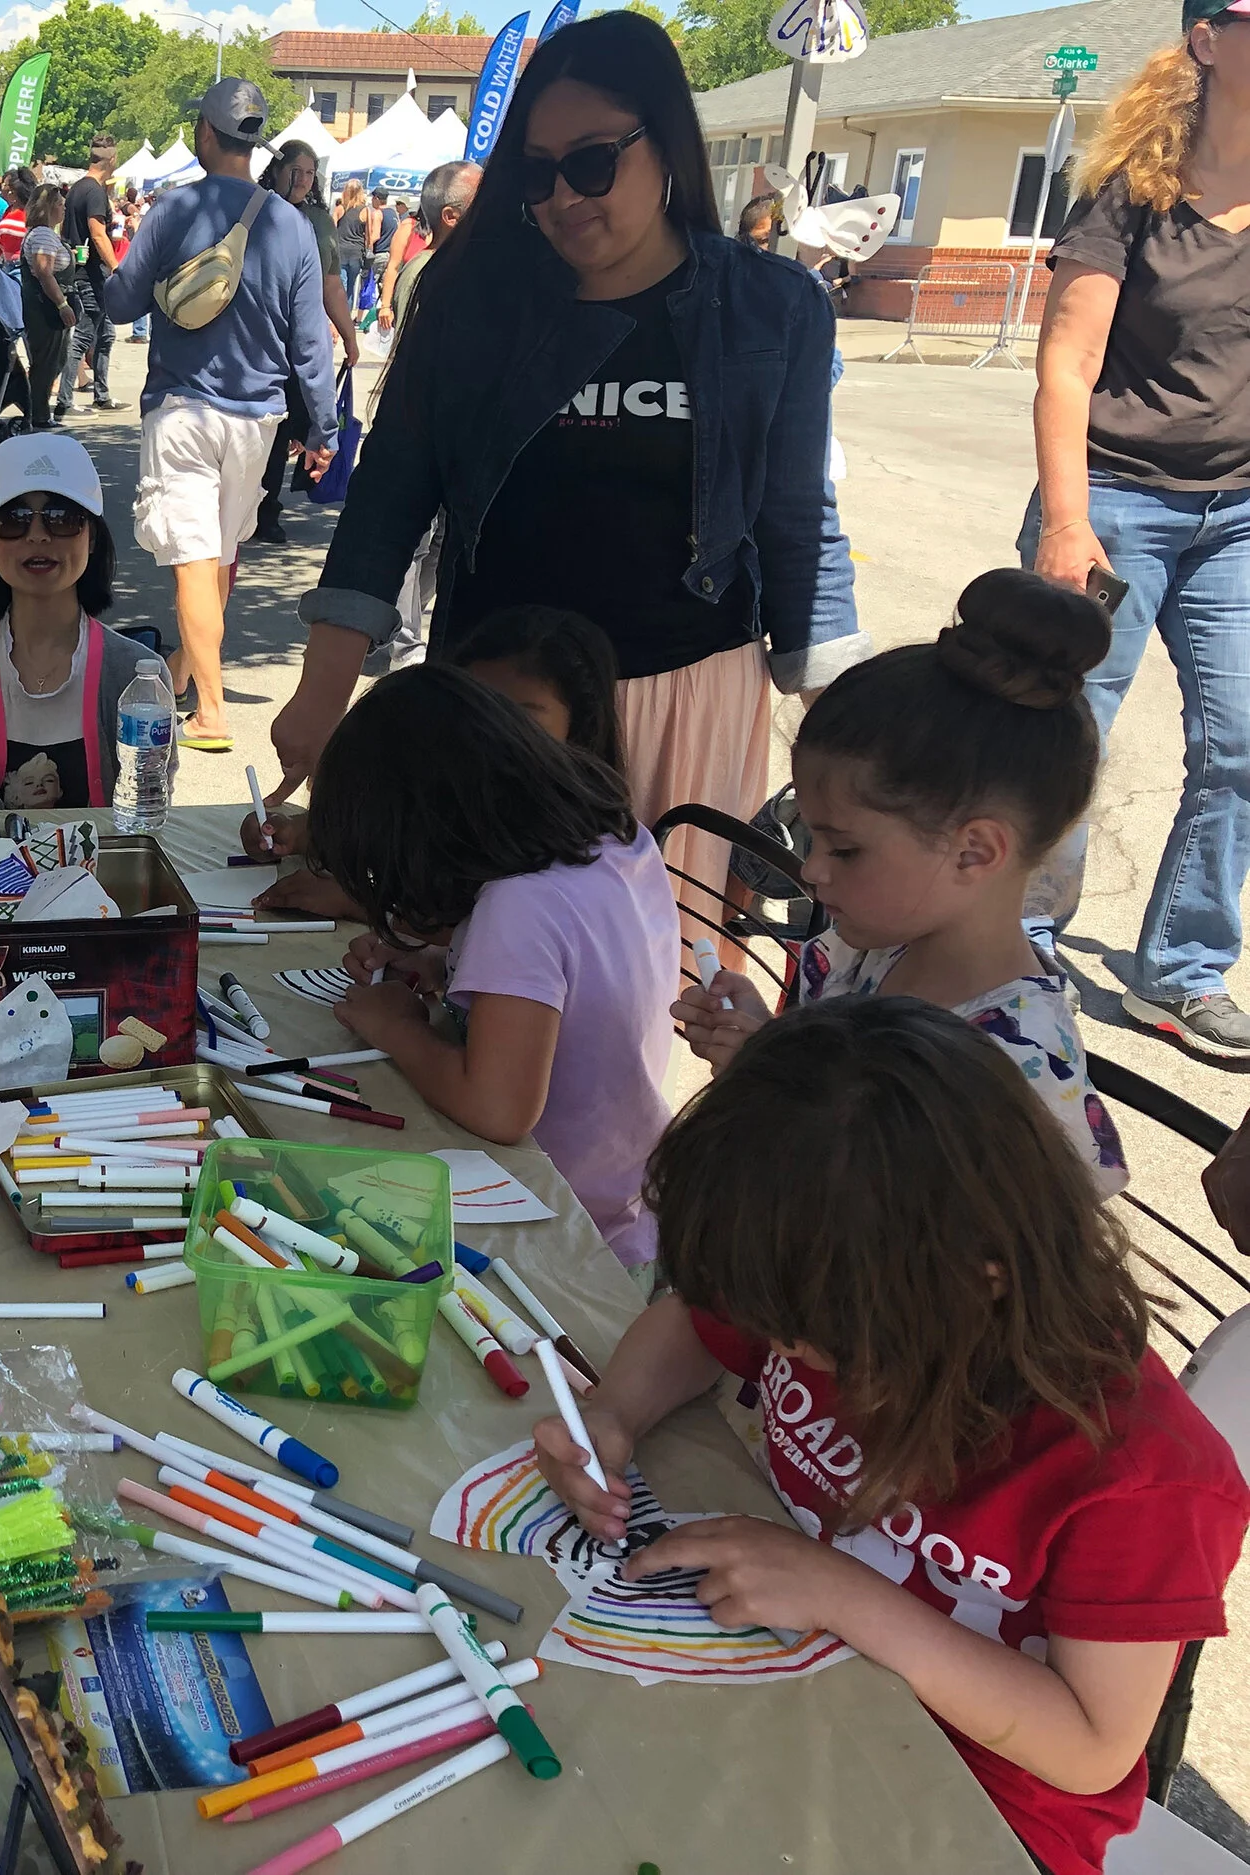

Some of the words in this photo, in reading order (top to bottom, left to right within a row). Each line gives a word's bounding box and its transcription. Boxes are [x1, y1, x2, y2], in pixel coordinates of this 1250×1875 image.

[1057, 57, 1089, 68] Clarke
[15, 75, 38, 125] HERE
[473, 90, 501, 151] COLD
[491, 28, 521, 87] WATER!
[558, 380, 692, 420] NICE
[582, 417, 621, 430] away!
[22, 945, 67, 954] KIRKLAND
[177, 1640, 190, 1678] FOOTBALL
[188, 1679, 211, 1732] REGISTRATION
[195, 1633, 217, 1677] LEANDRO
[210, 1677, 240, 1735] CRUSADERS
[293, 1767, 357, 1793] PRISMACOLOR
